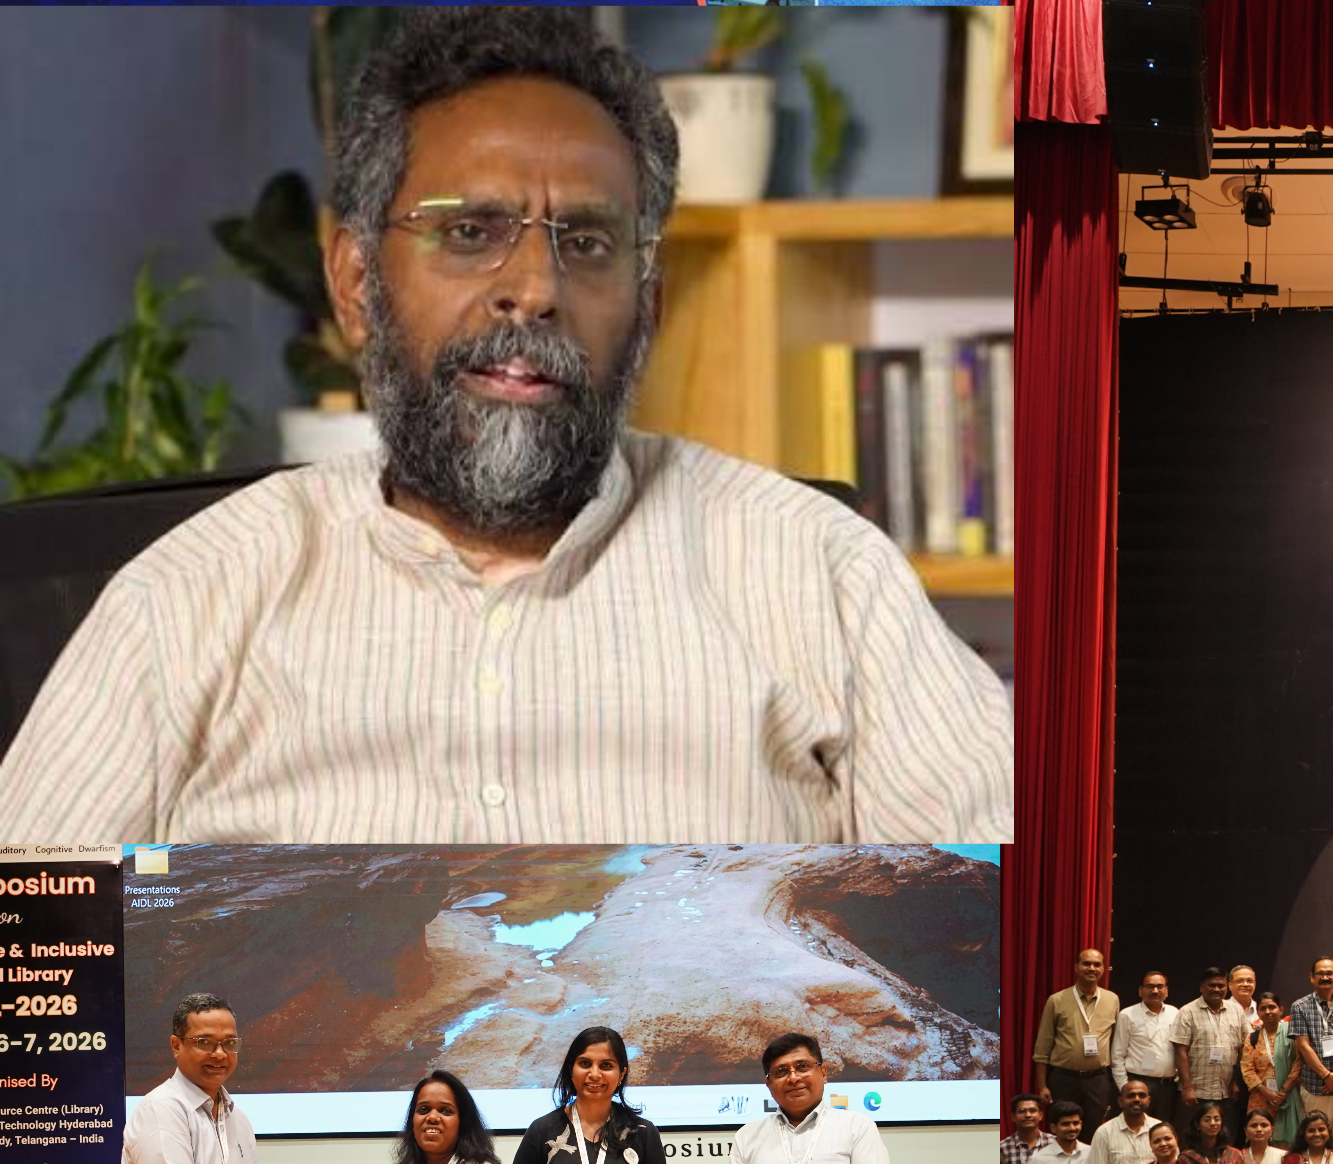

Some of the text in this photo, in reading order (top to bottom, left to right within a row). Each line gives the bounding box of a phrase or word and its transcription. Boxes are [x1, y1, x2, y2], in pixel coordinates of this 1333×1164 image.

[36, 846, 73, 855] Cognitive
[125, 886, 180, 894] Presentations
[131, 898, 174, 907] AIDL 2026
[9, 941, 114, 957] & Inclusive
[9, 967, 73, 985] Library
[49, 1032, 106, 1051] 2026
[42, 1074, 58, 1090] By
[25, 1104, 103, 1116] Centre (Library)
[59, 1119, 113, 1131] Hyderabad
[15, 1134, 104, 1145] Telangana India
